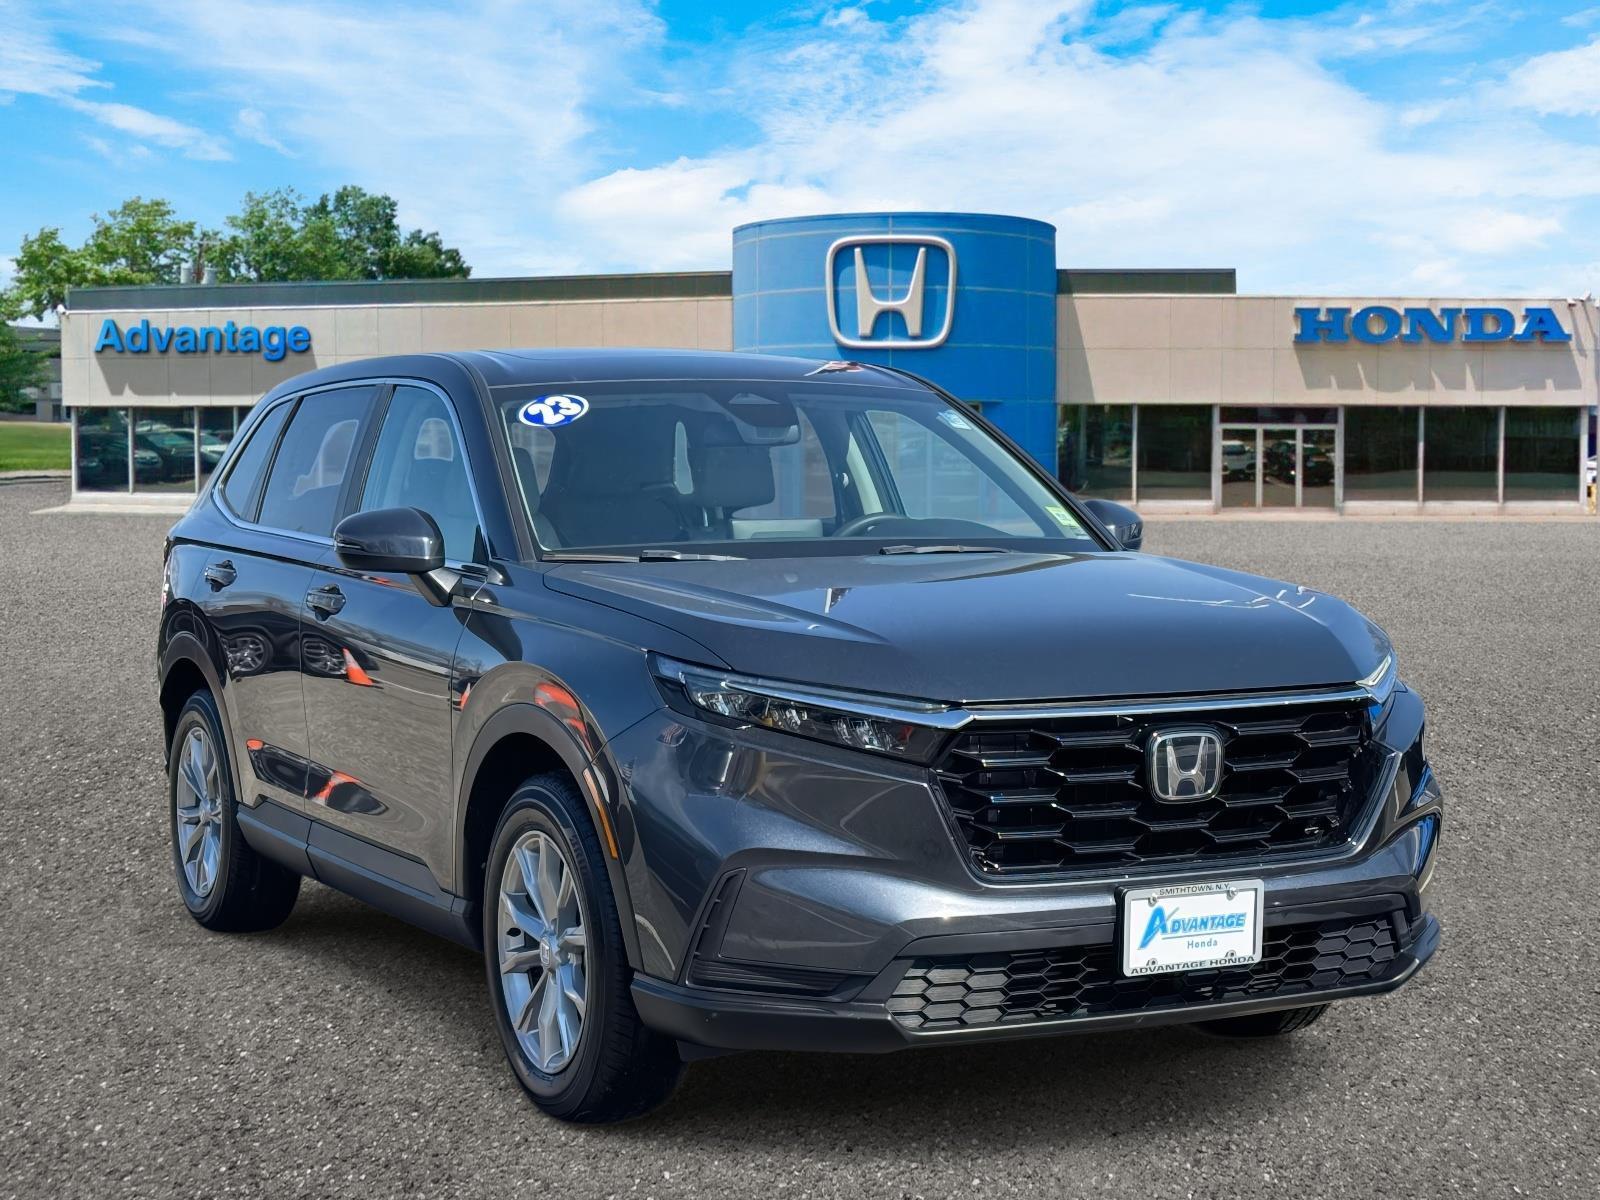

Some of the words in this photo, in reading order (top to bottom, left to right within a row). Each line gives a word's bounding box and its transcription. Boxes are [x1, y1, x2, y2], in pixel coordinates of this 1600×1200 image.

[1294, 306, 1572, 343] HONDA
[95, 319, 311, 361] Advantage
[527, 396, 582, 424] 23
[1187, 938, 1218, 950] Honda
[1131, 960, 1206, 974] ADVANTAGE
[1209, 955, 1255, 967] HONDA
